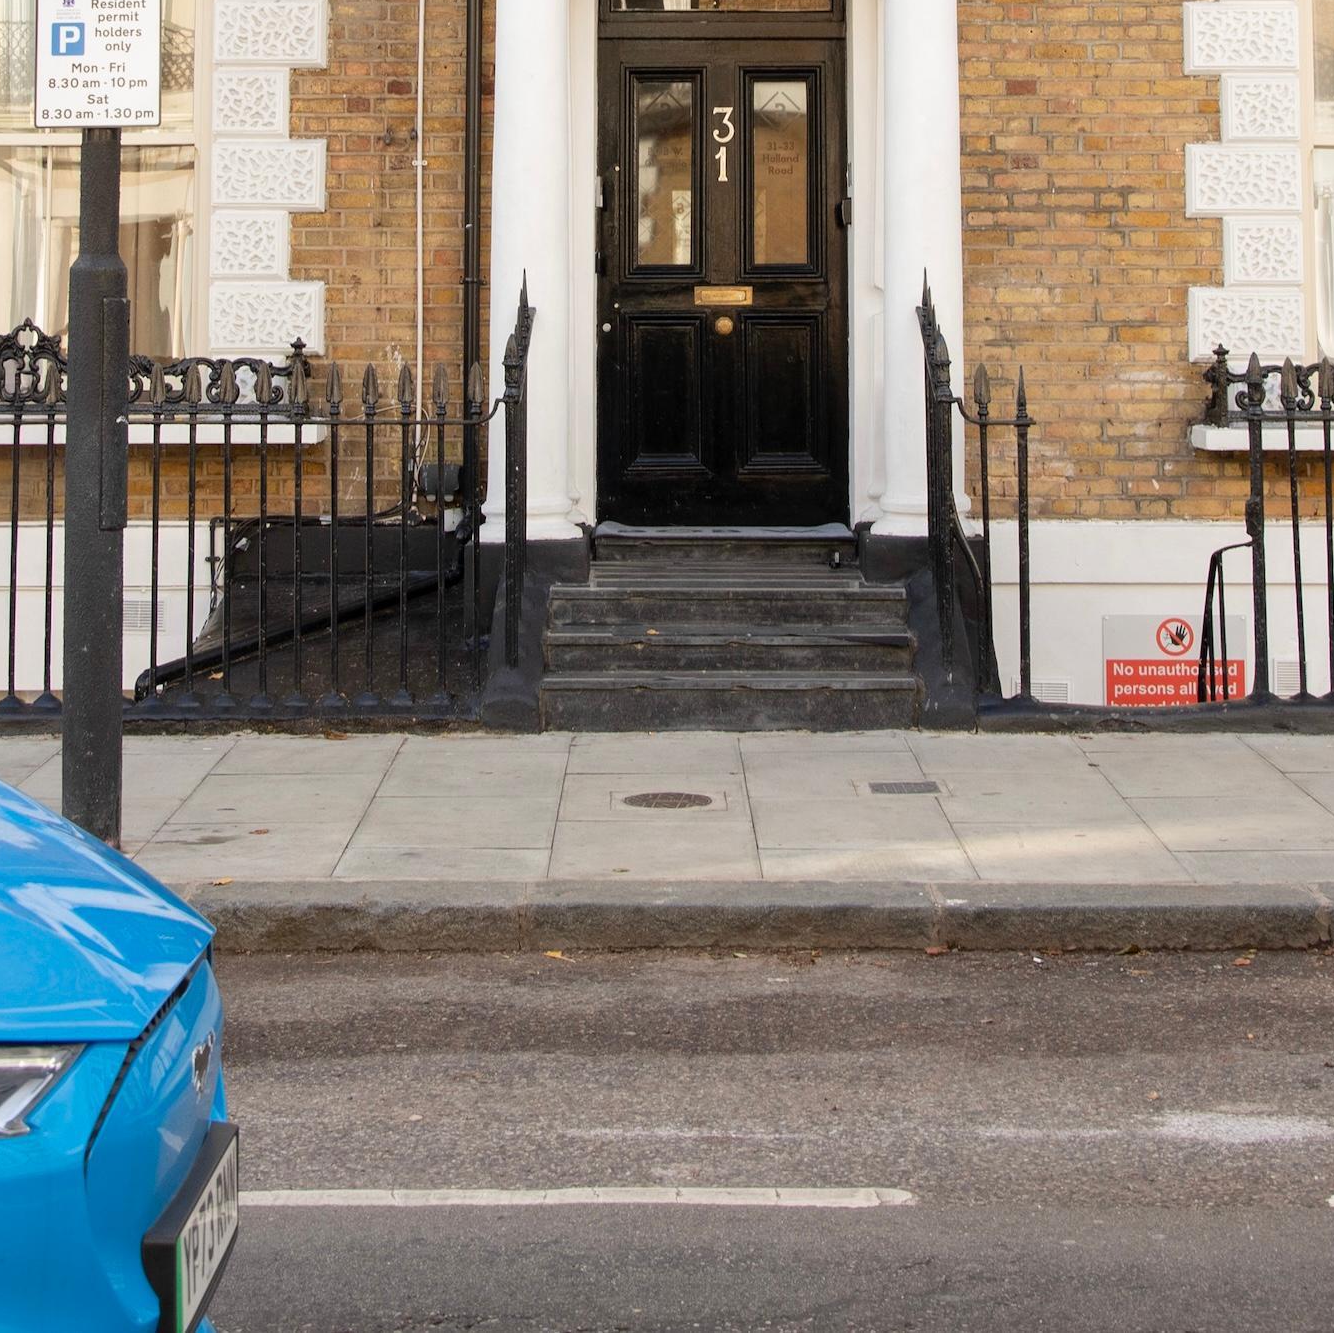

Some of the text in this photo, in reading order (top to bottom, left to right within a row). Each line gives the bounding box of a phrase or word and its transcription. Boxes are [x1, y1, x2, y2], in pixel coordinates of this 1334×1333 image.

[97, 11, 140, 23] permit
[94, 26, 142, 38] holders
[58, 25, 81, 54] P
[104, 41, 132, 53] only
[71, 62, 98, 74] Mon
[109, 62, 126, 73] Fri
[48, 77, 79, 89] 8.30
[82, 79, 101, 88] am
[110, 77, 126, 88] 10
[128, 79, 148, 89] pm
[86, 94, 109, 105] Sat
[41, 108, 73, 120] 8.30
[75, 110, 94, 119] am
[104, 108, 132, 119] 1.30
[135, 110, 155, 120] pm
[762, 154, 800, 164] Holland
[767, 166, 794, 175] Road
[1113, 662, 1135, 676] No
[1114, 682, 1237, 698] persons allwed
